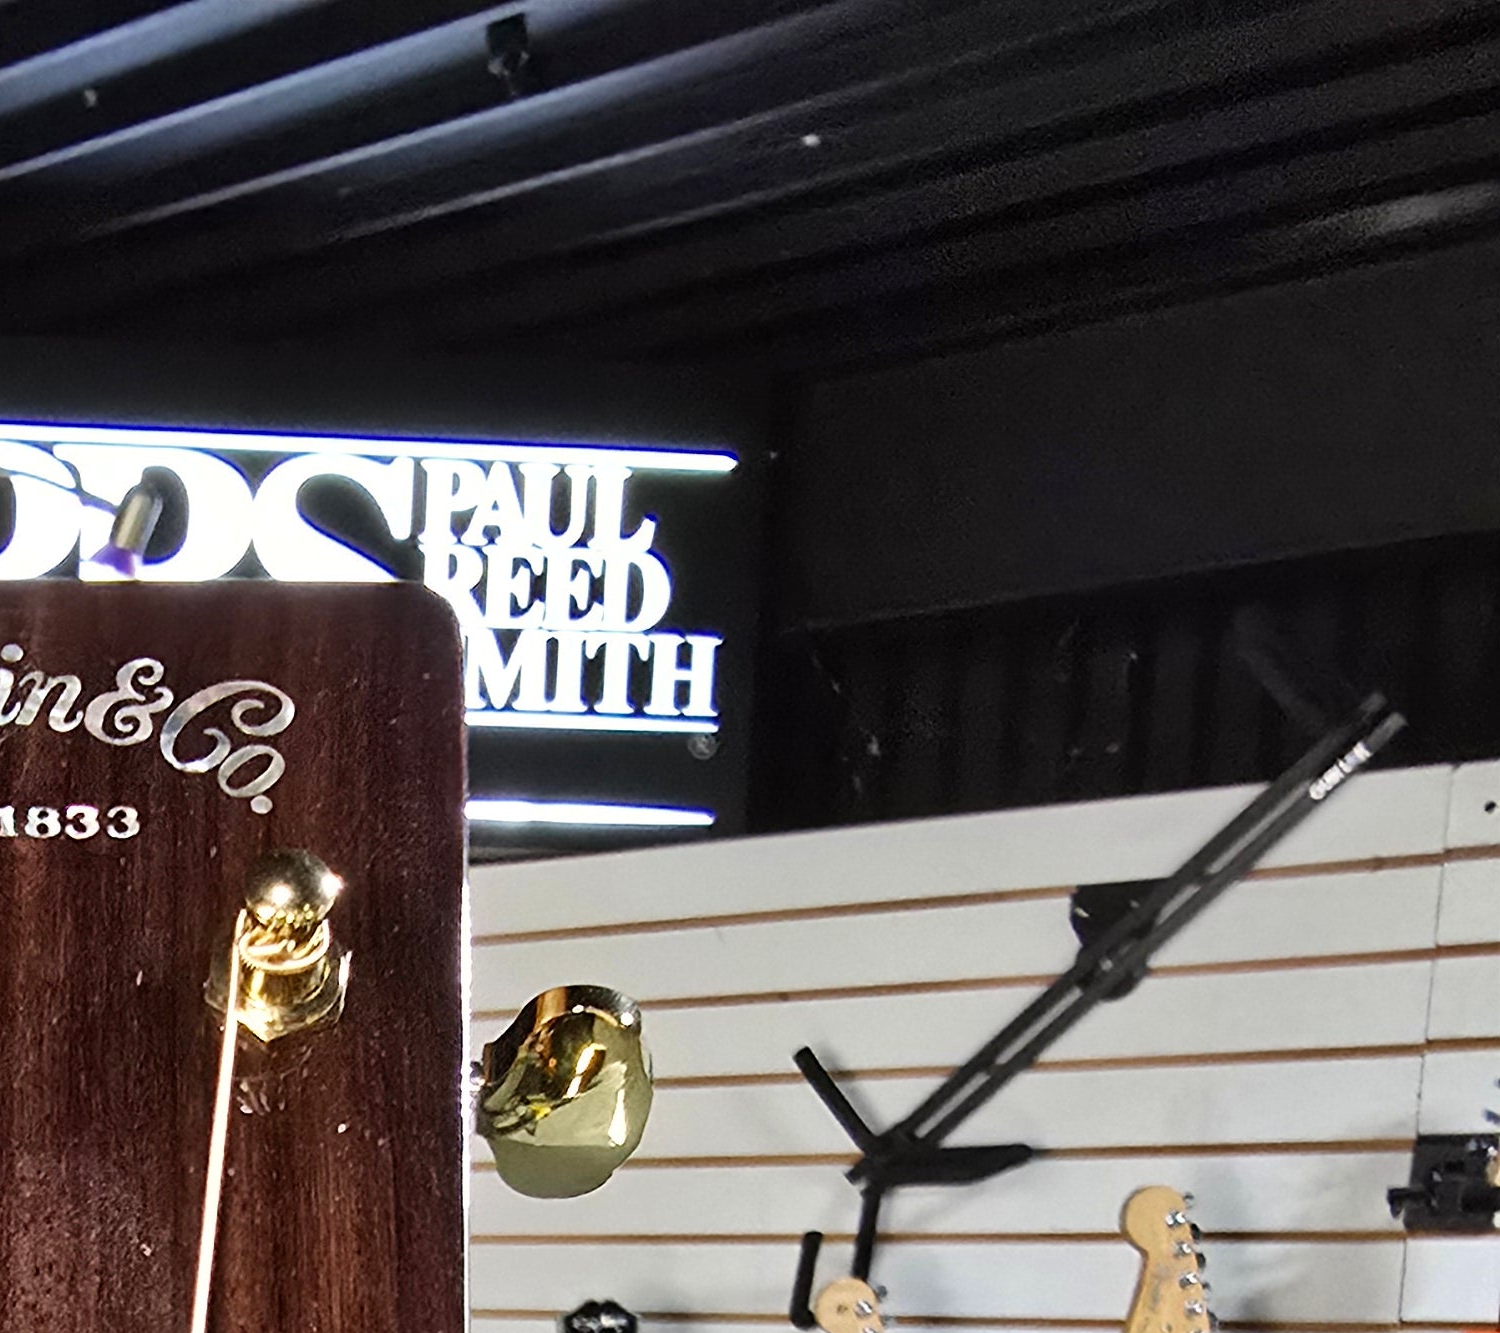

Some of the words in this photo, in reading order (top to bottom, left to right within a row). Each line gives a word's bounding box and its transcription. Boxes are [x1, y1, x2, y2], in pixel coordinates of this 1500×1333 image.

[419, 457, 657, 549] PAUL
[422, 544, 673, 632] REED
[462, 627, 724, 717] MITH
